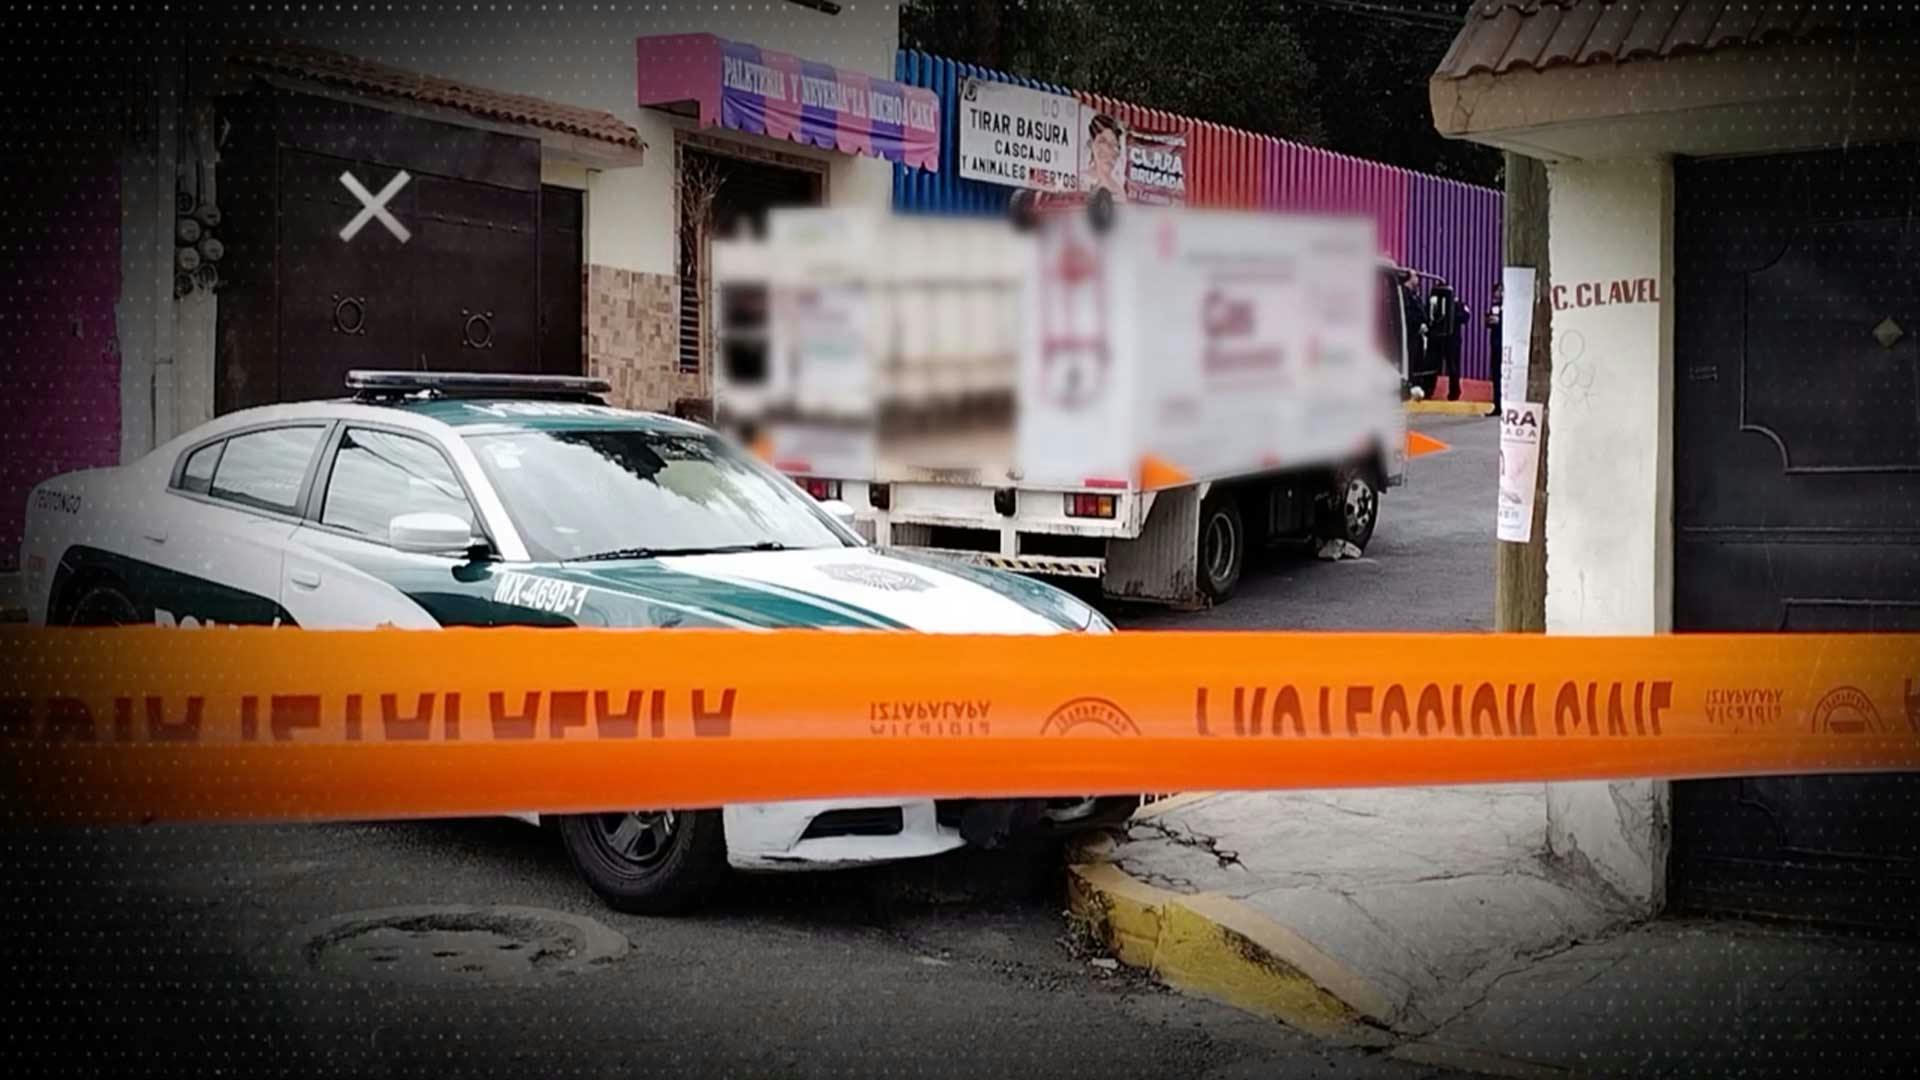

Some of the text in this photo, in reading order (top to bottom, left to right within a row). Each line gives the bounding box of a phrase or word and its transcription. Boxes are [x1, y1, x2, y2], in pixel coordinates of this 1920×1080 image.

[789, 73, 799, 103] Y
[970, 108, 1010, 136] TIRAR
[1016, 117, 1069, 147] BASURA
[995, 140, 1051, 163] CASCAJO
[1130, 147, 1184, 174] CLARA
[972, 156, 1026, 180] ANIMALES
[1029, 167, 1076, 189] MUERTOS
